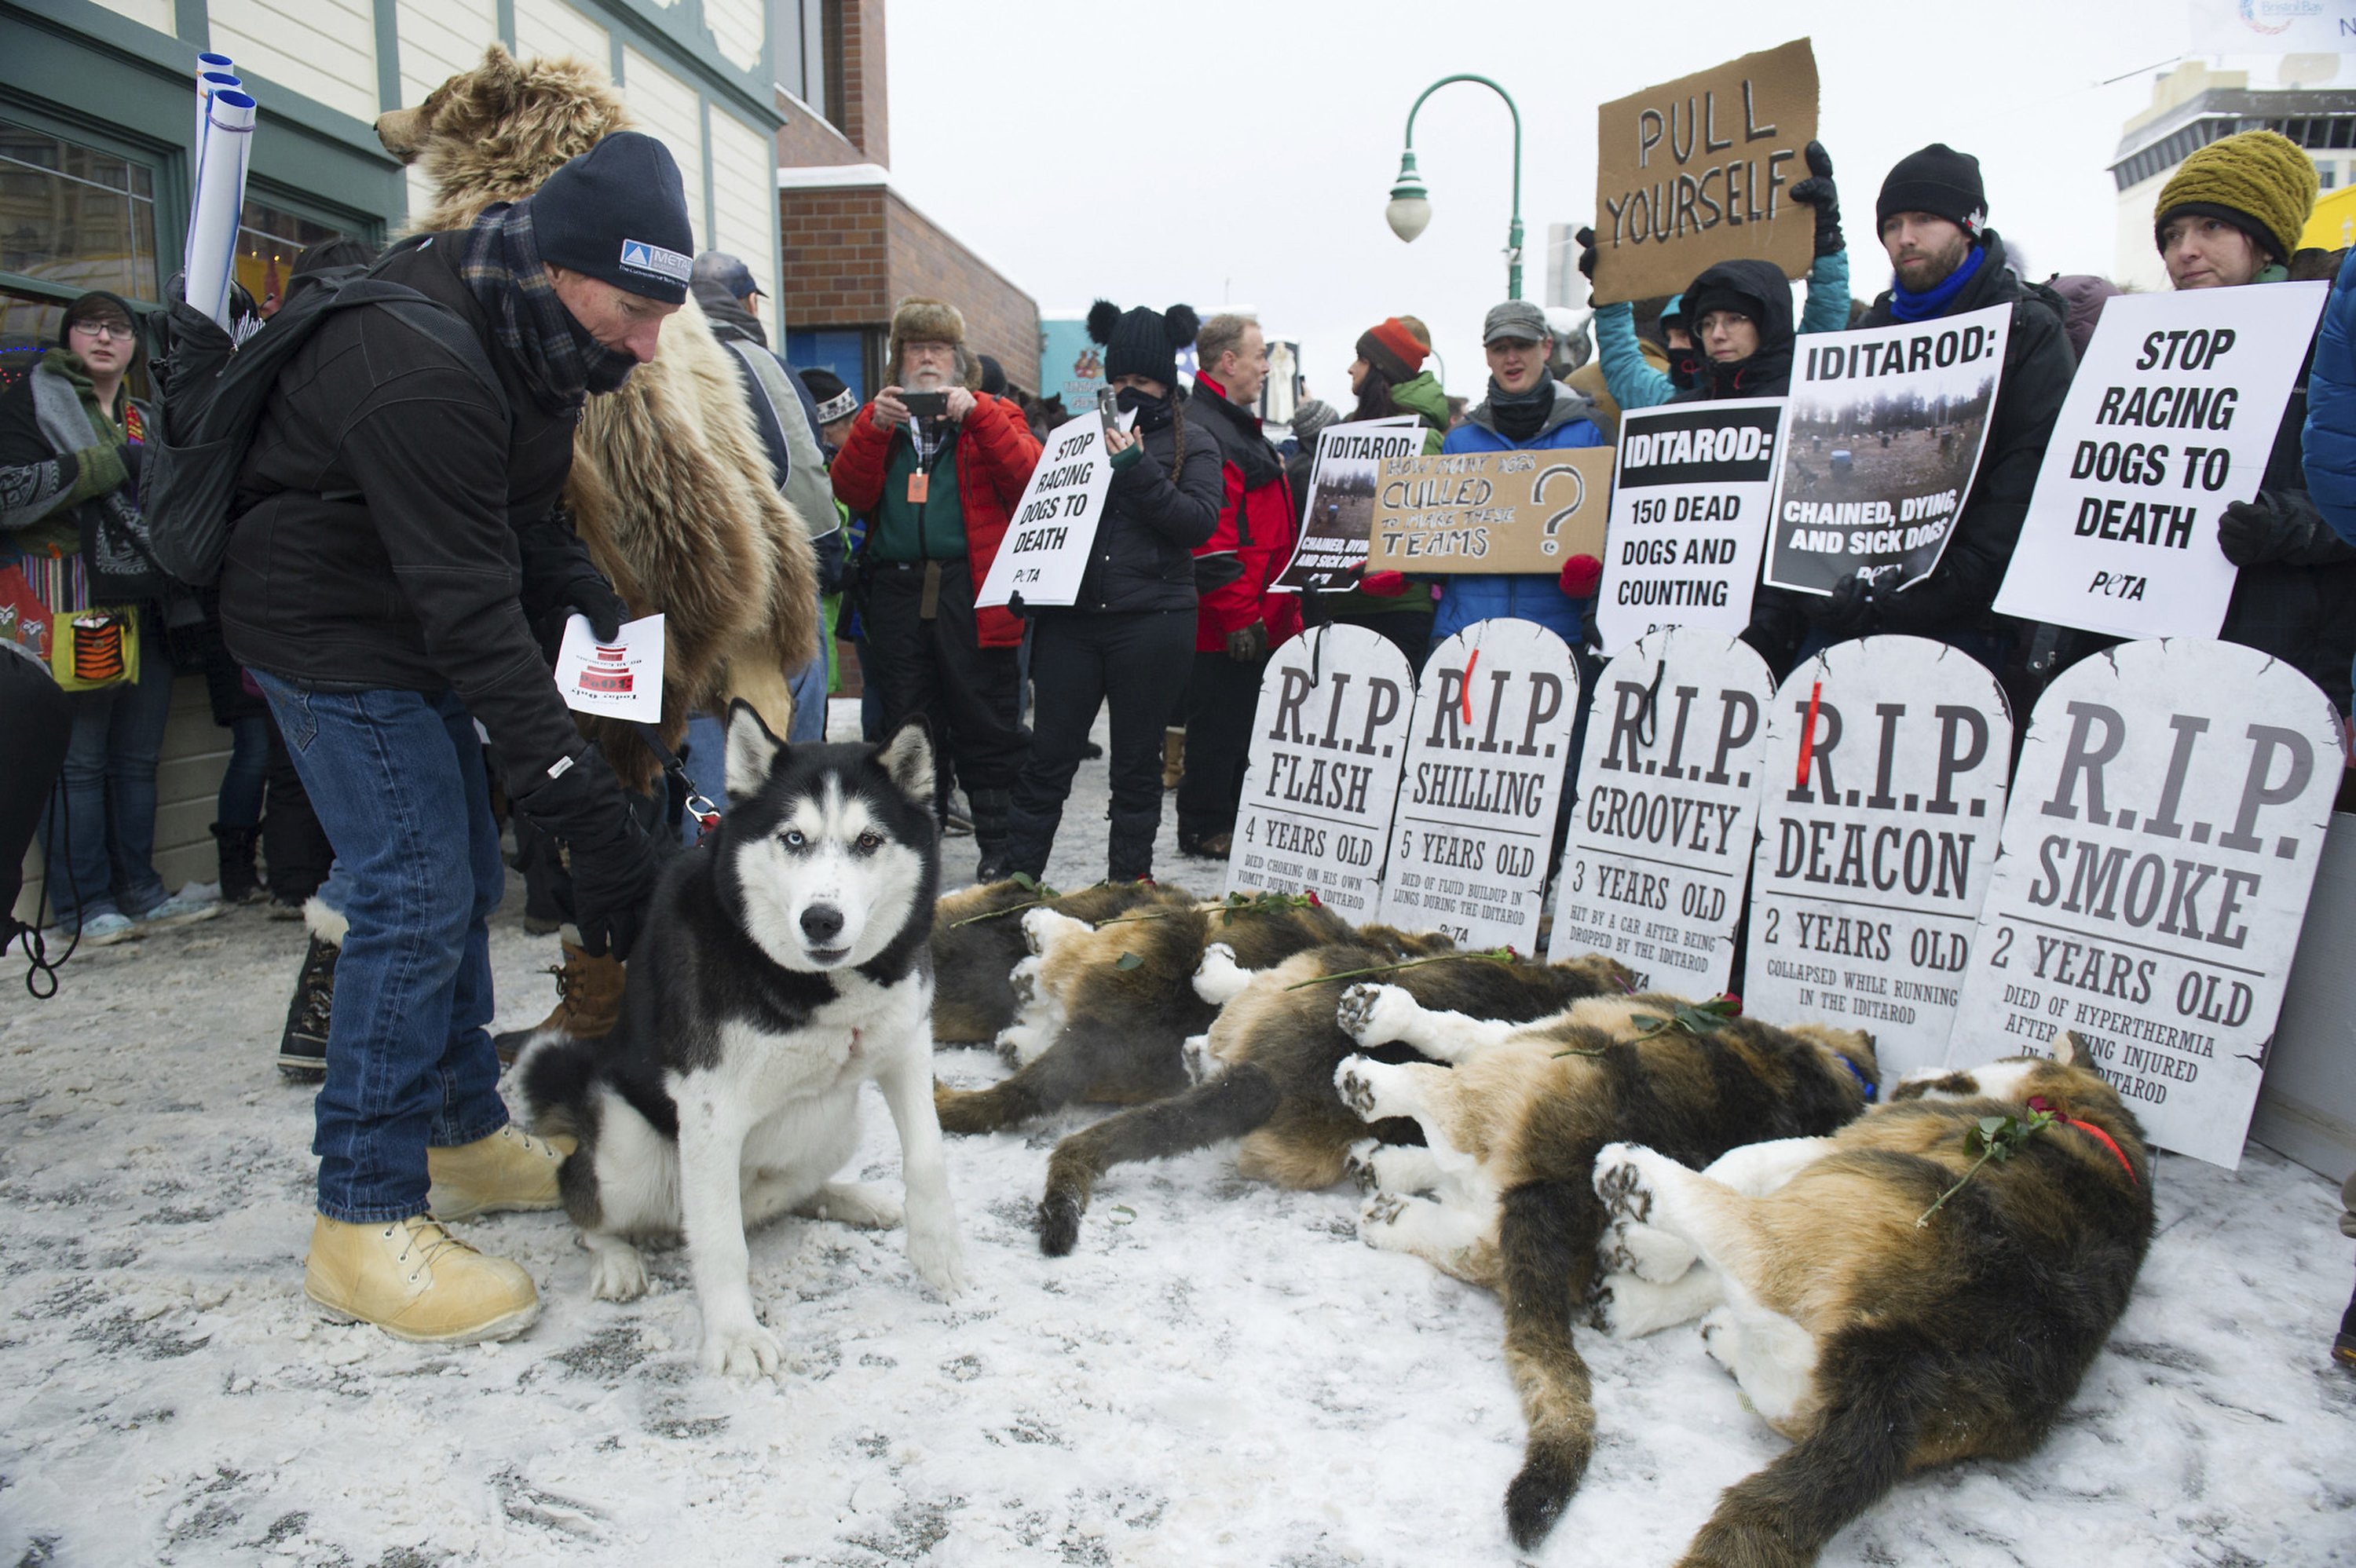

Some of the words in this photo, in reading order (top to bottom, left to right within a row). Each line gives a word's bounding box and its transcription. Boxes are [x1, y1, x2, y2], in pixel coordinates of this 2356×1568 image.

[1638, 79, 1776, 168] PULL
[1607, 149, 1794, 248] YOURSELF
[1805, 325, 1996, 382] IDITAROD:
[2136, 328, 2237, 371] STOP
[2094, 386, 2239, 431] RACING
[1055, 432, 1096, 462] STOP
[1327, 437, 1417, 460] IDITAROD:
[1387, 458, 1432, 477] HOW
[1436, 454, 1491, 475] MANY
[1497, 454, 1537, 473] DOGS
[1624, 426, 1773, 469] IDITAROD:
[2069, 440, 2169, 487] DOGS
[2182, 446, 2231, 492] TO
[1035, 462, 1094, 495] RACING
[1381, 477, 1493, 510] CULLED
[1019, 496, 1061, 526] DOGS
[1063, 493, 1088, 517] TO
[1381, 518, 1398, 528] TO
[1463, 506, 1516, 526] THESE
[1531, 463, 1586, 556] ?
[1632, 498, 1666, 524] 150
[1674, 495, 1741, 521] DEAD
[1783, 500, 1897, 528] CHAINED,
[2074, 496, 2197, 550] DEATH
[1012, 527, 1069, 554] DEATH
[1301, 536, 1345, 554] CHAINED,
[1344, 539, 1370, 554] DYIN
[1380, 527, 1491, 559] TEAMS
[1622, 539, 1677, 565] DOGS
[1684, 539, 1736, 565] AND
[1788, 528, 1845, 554] AND
[1848, 528, 1904, 555] SICK
[1904, 517, 1949, 551] DOGS
[1294, 554, 1319, 567] AND
[1315, 554, 1341, 568] SICK
[1618, 579, 1729, 607] COUNTING
[1268, 666, 1401, 758] R.I.P.
[1425, 667, 1564, 758] R.I.P.
[1601, 681, 1760, 788] R.I.P.
[1786, 699, 1989, 818] R.I.P.
[2040, 700, 2315, 861] R.I.P.
[1265, 752, 1374, 813] FLASH
[1413, 762, 1546, 818] SHILLING
[1246, 816, 1256, 842] 4
[1266, 819, 1327, 857] YEARS
[1337, 834, 1373, 866] OLD
[1587, 784, 1740, 856] GROOVEY
[1245, 853, 1264, 869] DIED
[1267, 859, 1304, 879] CHOKING
[1307, 868, 1319, 882] ON
[1322, 871, 1338, 886] HIS
[1341, 875, 1363, 891] OWN
[1401, 830, 1412, 858] 5
[1423, 833, 1486, 871] YEARS
[1496, 844, 1535, 878] OLD
[1774, 817, 1976, 901] DEACON
[1238, 869, 1264, 887] VOMIT
[1267, 876, 1299, 894] DURING
[1323, 889, 1365, 910] IDITAROD
[1393, 889, 1420, 906] LUNGS
[1423, 894, 1457, 913] DURING
[1460, 901, 1479, 918] THE
[1481, 904, 1526, 926] IDITAROD
[1401, 872, 1421, 887] DIED
[1424, 875, 1436, 890] OF
[1438, 879, 1465, 897] FLUID
[1468, 883, 1508, 904] BUILDUP
[1511, 890, 1523, 906] IN
[1573, 861, 1585, 892] 3
[1597, 864, 1670, 911] YEARS
[1681, 883, 1726, 922] OLD
[2028, 834, 2261, 950] SMOKE
[1569, 926, 1612, 949] DROPPED
[1615, 937, 1630, 954] BY
[1634, 941, 1655, 960] THE
[1659, 947, 1709, 973] IDITAROD
[1570, 905, 1589, 922] HIT
[1591, 910, 1605, 926] BY
[1608, 914, 1615, 929] A
[1620, 916, 1641, 935] CAR
[1645, 923, 1679, 944] AFTER
[1683, 931, 1716, 952] BEING
[1765, 908, 1780, 945] 2
[1797, 912, 1892, 962] YEARS
[1910, 927, 1969, 972] OLD
[1767, 959, 1837, 986] COLLAPSED
[1843, 971, 1888, 995] WHILE
[1894, 980, 1959, 1007] RUNNING
[1990, 927, 2014, 969] 2
[2033, 934, 2157, 1005] YEARS
[2176, 970, 2254, 1028] OLD
[1799, 988, 1815, 1006] IN
[1821, 992, 1846, 1013] THE
[1853, 997, 1916, 1025] IDITAROD
[2003, 984, 2041, 1011] DIED
[2048, 996, 2069, 1018] OF
[2074, 1003, 2216, 1058] HYPERTHERMIA
[2005, 1013, 2058, 1043] AFTER
[2123, 1045, 2199, 1084] INJURED
